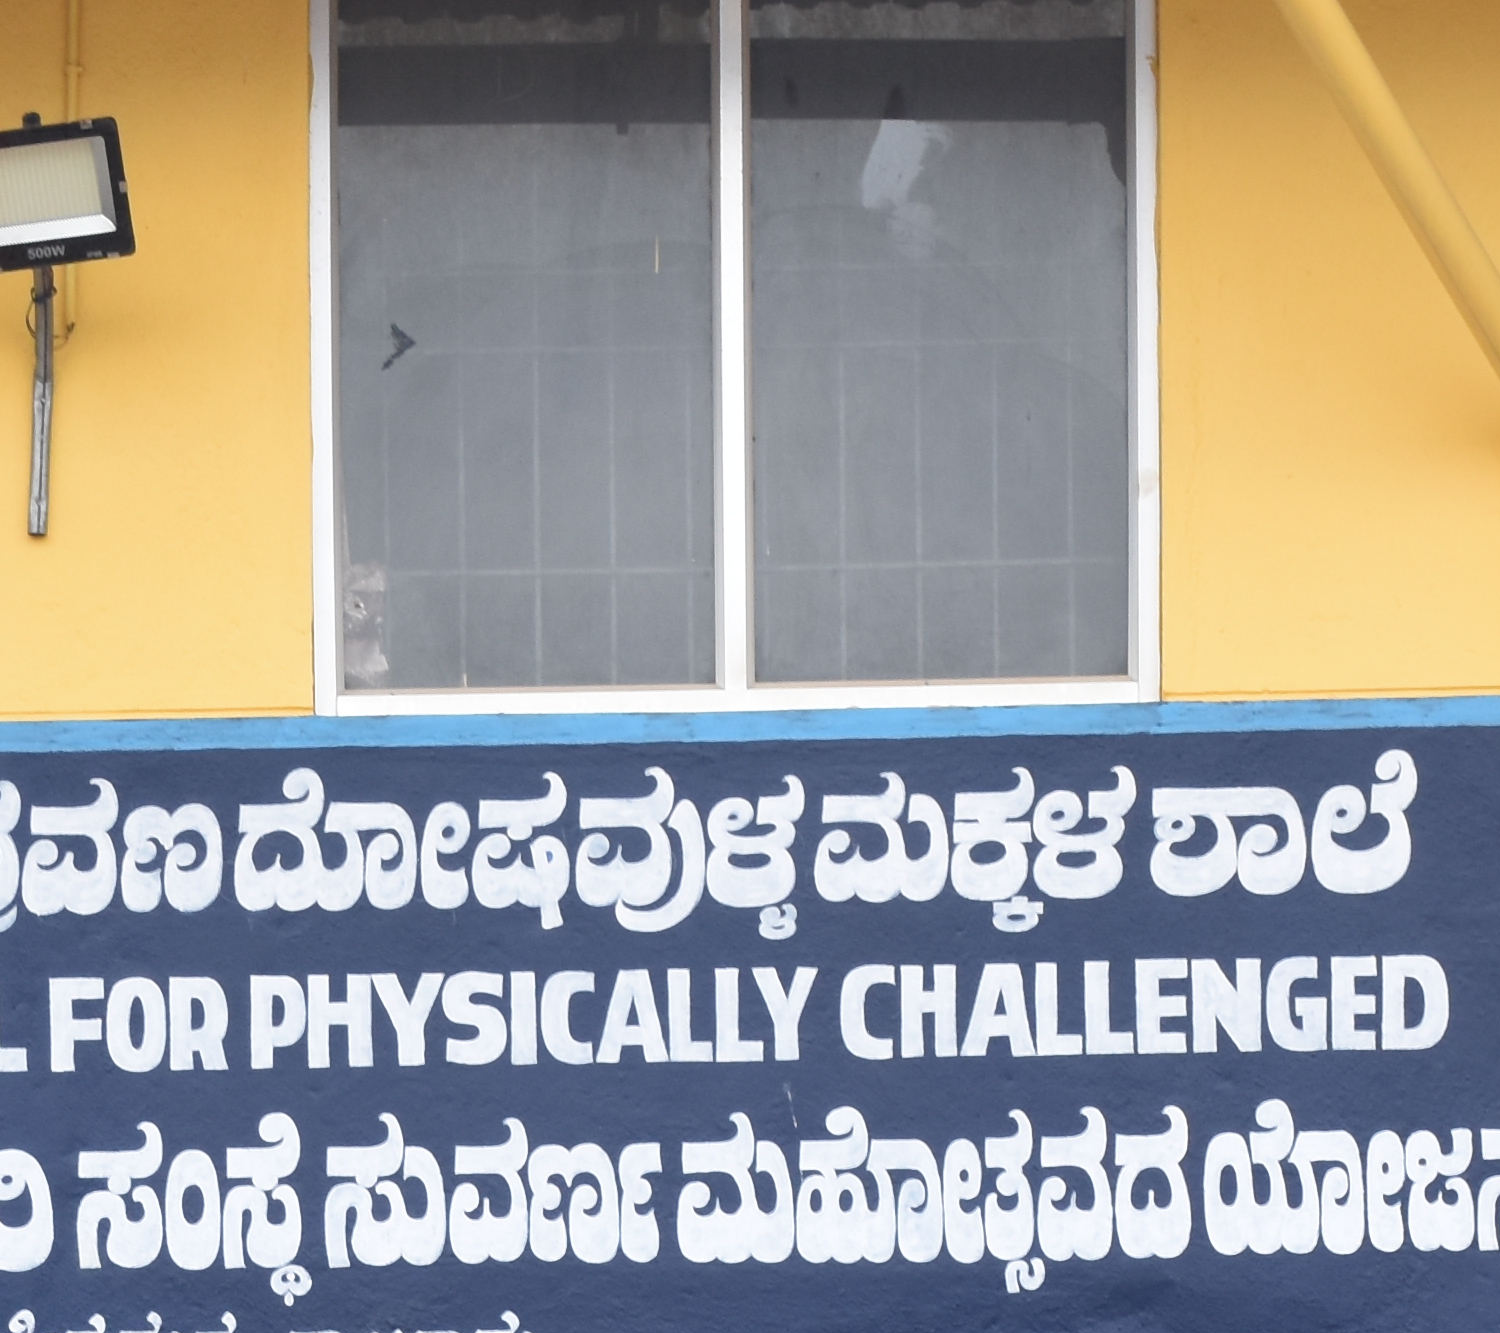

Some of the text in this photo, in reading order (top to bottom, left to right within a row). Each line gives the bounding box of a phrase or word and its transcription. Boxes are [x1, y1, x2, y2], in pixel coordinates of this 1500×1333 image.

[27, 244, 66, 260] 500W
[232, 765, 807, 942] ದೋಷವುಳ್ಳ
[812, 763, 1138, 934] ಮಕ್ಕಳ
[1148, 758, 1419, 898] ಶಾಲೆ
[47, 975, 230, 1074] FOR
[248, 965, 820, 1071] PHYSICALLY
[838, 953, 1451, 1062] CHALLENGED
[74, 1110, 314, 1308] ಸಂಸ್ಥೆ
[322, 1111, 664, 1270] ಸುವರ್ಣ
[675, 1103, 1194, 1295] ಮಹೋತ್ಸವದ
